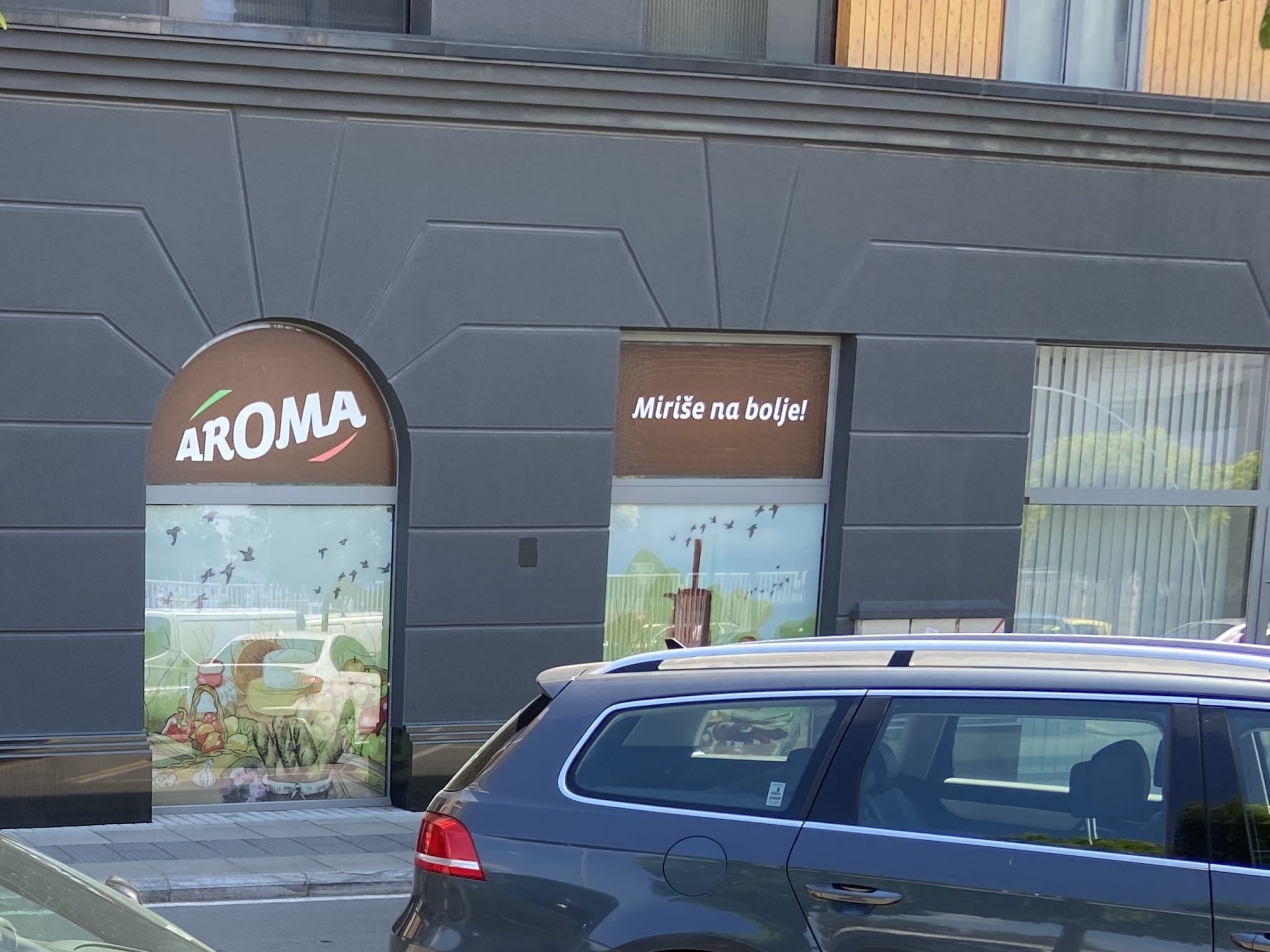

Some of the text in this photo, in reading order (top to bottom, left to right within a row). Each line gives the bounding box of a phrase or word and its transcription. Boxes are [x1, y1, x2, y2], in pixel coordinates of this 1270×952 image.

[175, 391, 367, 461] AROMA
[632, 395, 809, 427] Miriše na bolje!
